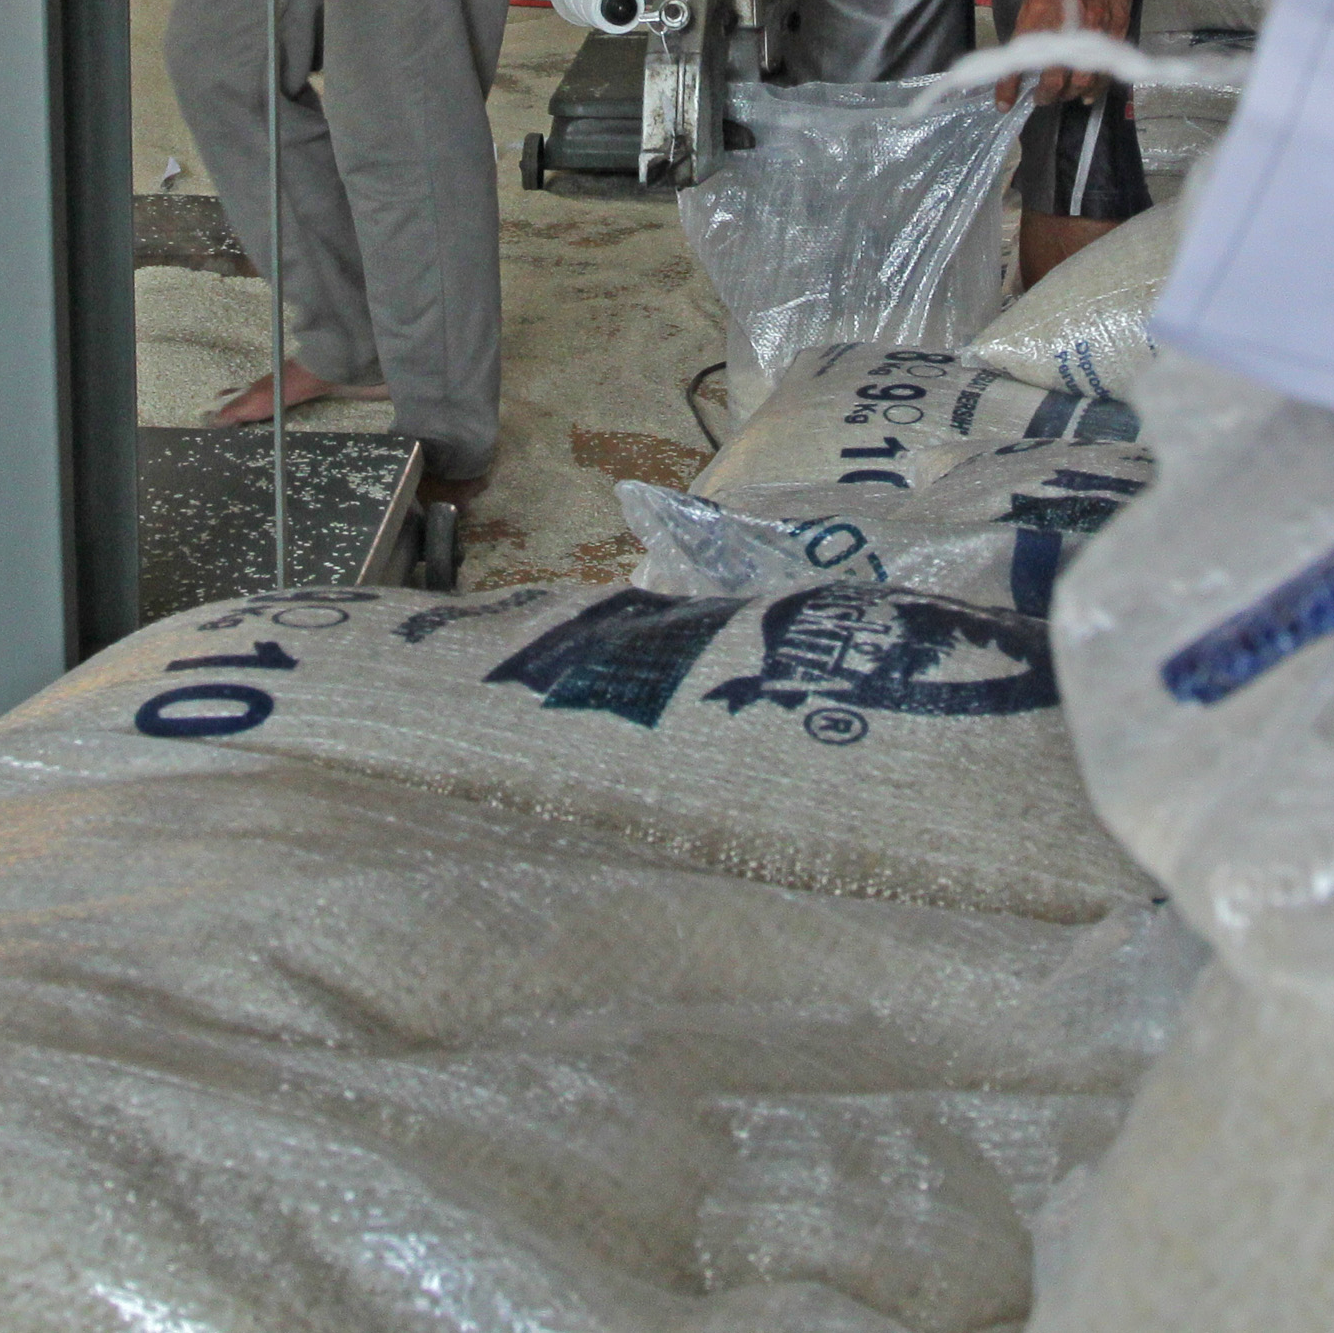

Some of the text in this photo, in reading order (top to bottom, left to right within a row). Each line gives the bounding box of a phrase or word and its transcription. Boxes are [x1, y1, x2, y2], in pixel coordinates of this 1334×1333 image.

[856, 384, 927, 401] 9
[845, 403, 878, 424] Kg
[134, 641, 300, 738] 10
